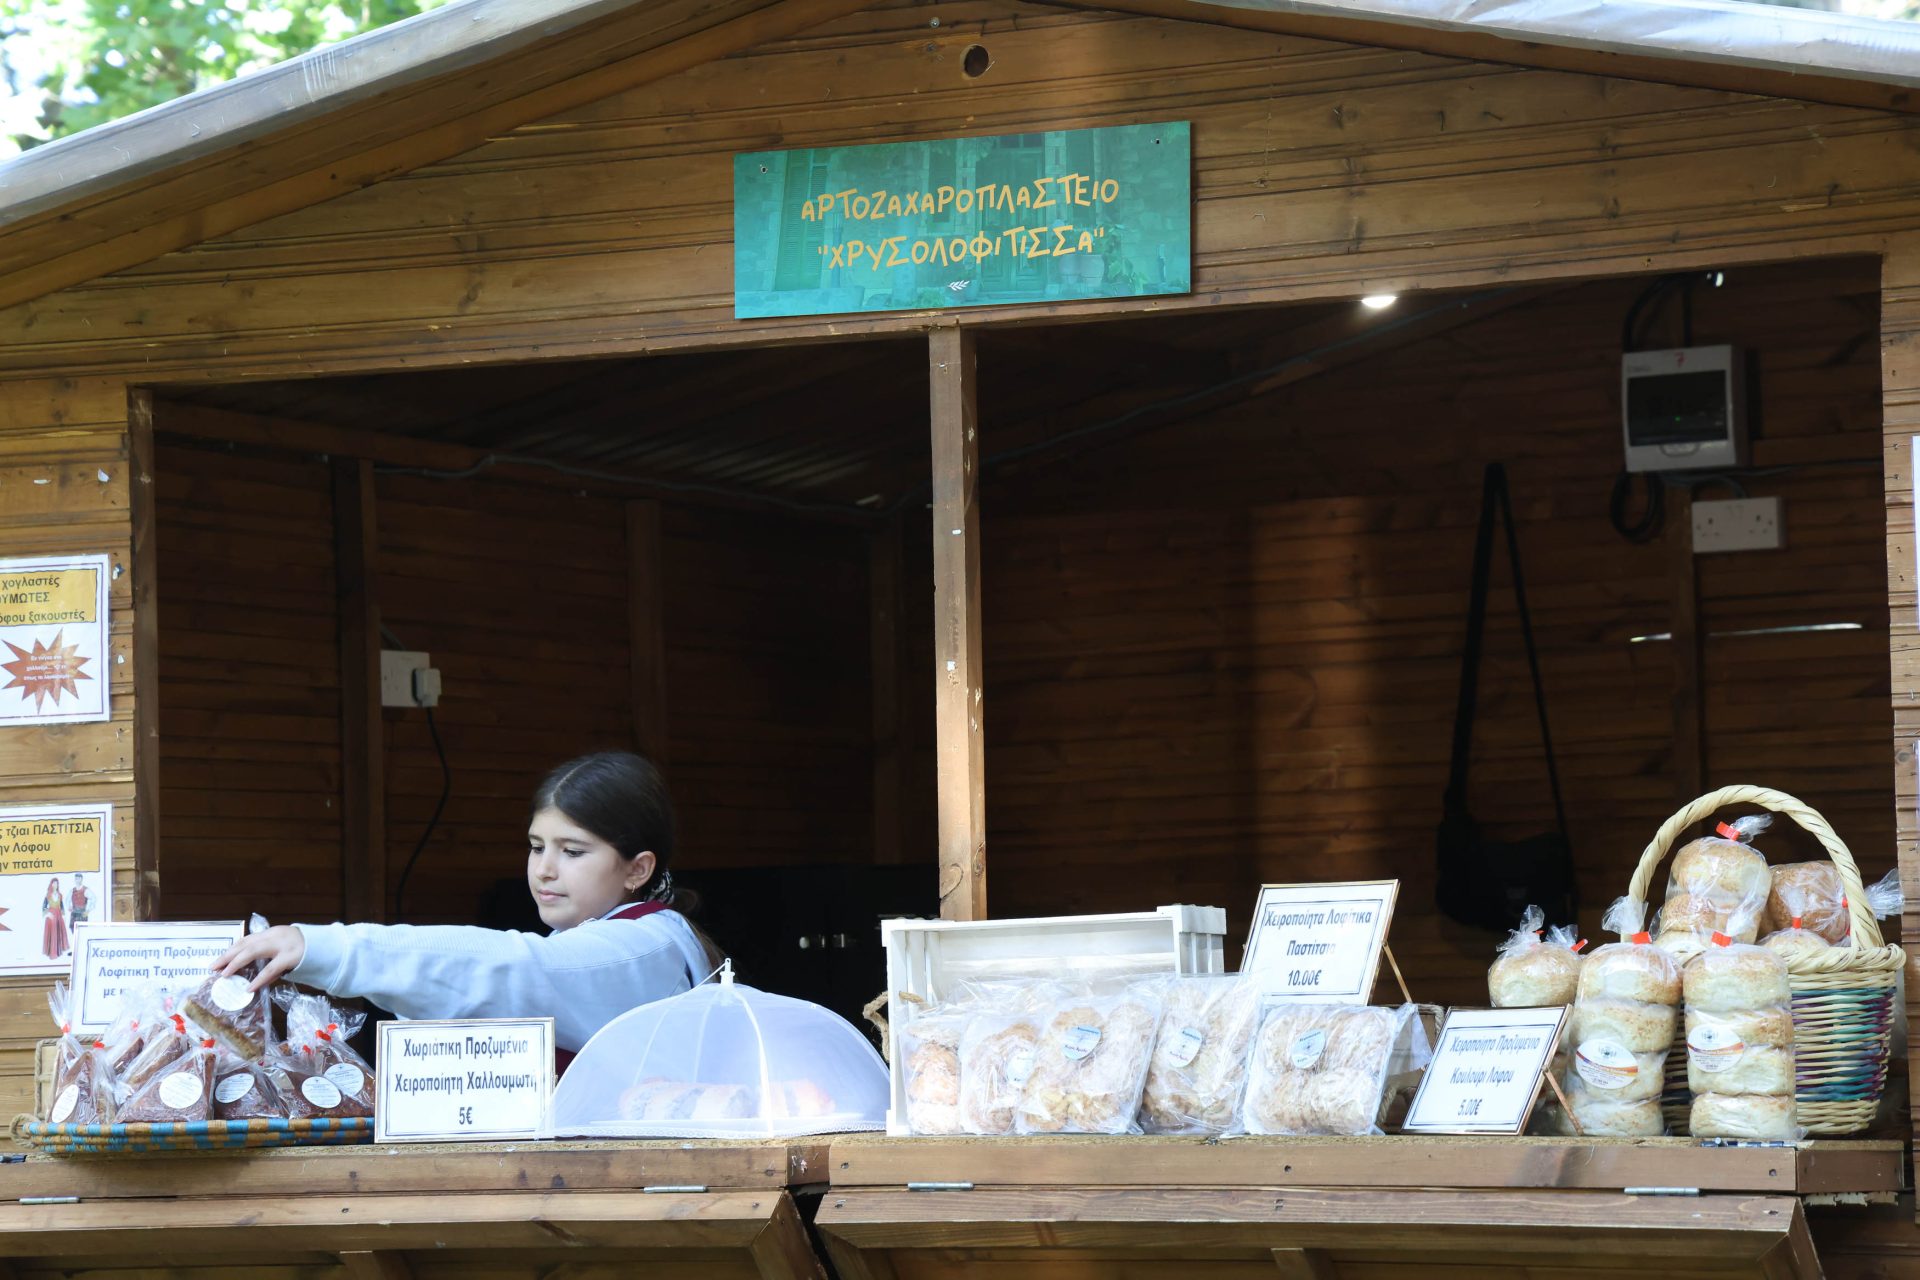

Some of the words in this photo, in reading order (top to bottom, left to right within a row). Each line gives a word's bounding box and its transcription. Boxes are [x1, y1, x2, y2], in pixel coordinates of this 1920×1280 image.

[801, 173, 1119, 222] ΑΡΤΟΖΑΧΑΡΟΠΛΑΣΤΕΙΟ
[818, 226, 1105, 272] "ΧΡΥΣΟΛΟΦΙΤΙΣΣΑ"
[2, 575, 61, 591] χογλαστές
[0, 592, 50, 604] ΥΜΩΤΕΣ
[28, 609, 86, 623] ξακουστές
[33, 822, 94, 836] ΠΑΣΤΙΤΣΙΑ
[12, 841, 51, 854] Λόφου
[12, 857, 53, 870] πατάτα
[1264, 908, 1325, 931] Χειροποίητα
[91, 947, 160, 960] Χειροποίητη
[1286, 939, 1336, 957] Παστίτσια
[98, 966, 150, 979] Λοφίτικη
[1287, 969, 1322, 987] 10.00€
[403, 1038, 462, 1061] Χωριάτικη
[465, 1036, 529, 1060] Προζυμένια
[394, 1072, 463, 1096] Χειροποίητη
[466, 1069, 538, 1093] Χαλλουμωτή
[458, 1107, 473, 1126] 5€
